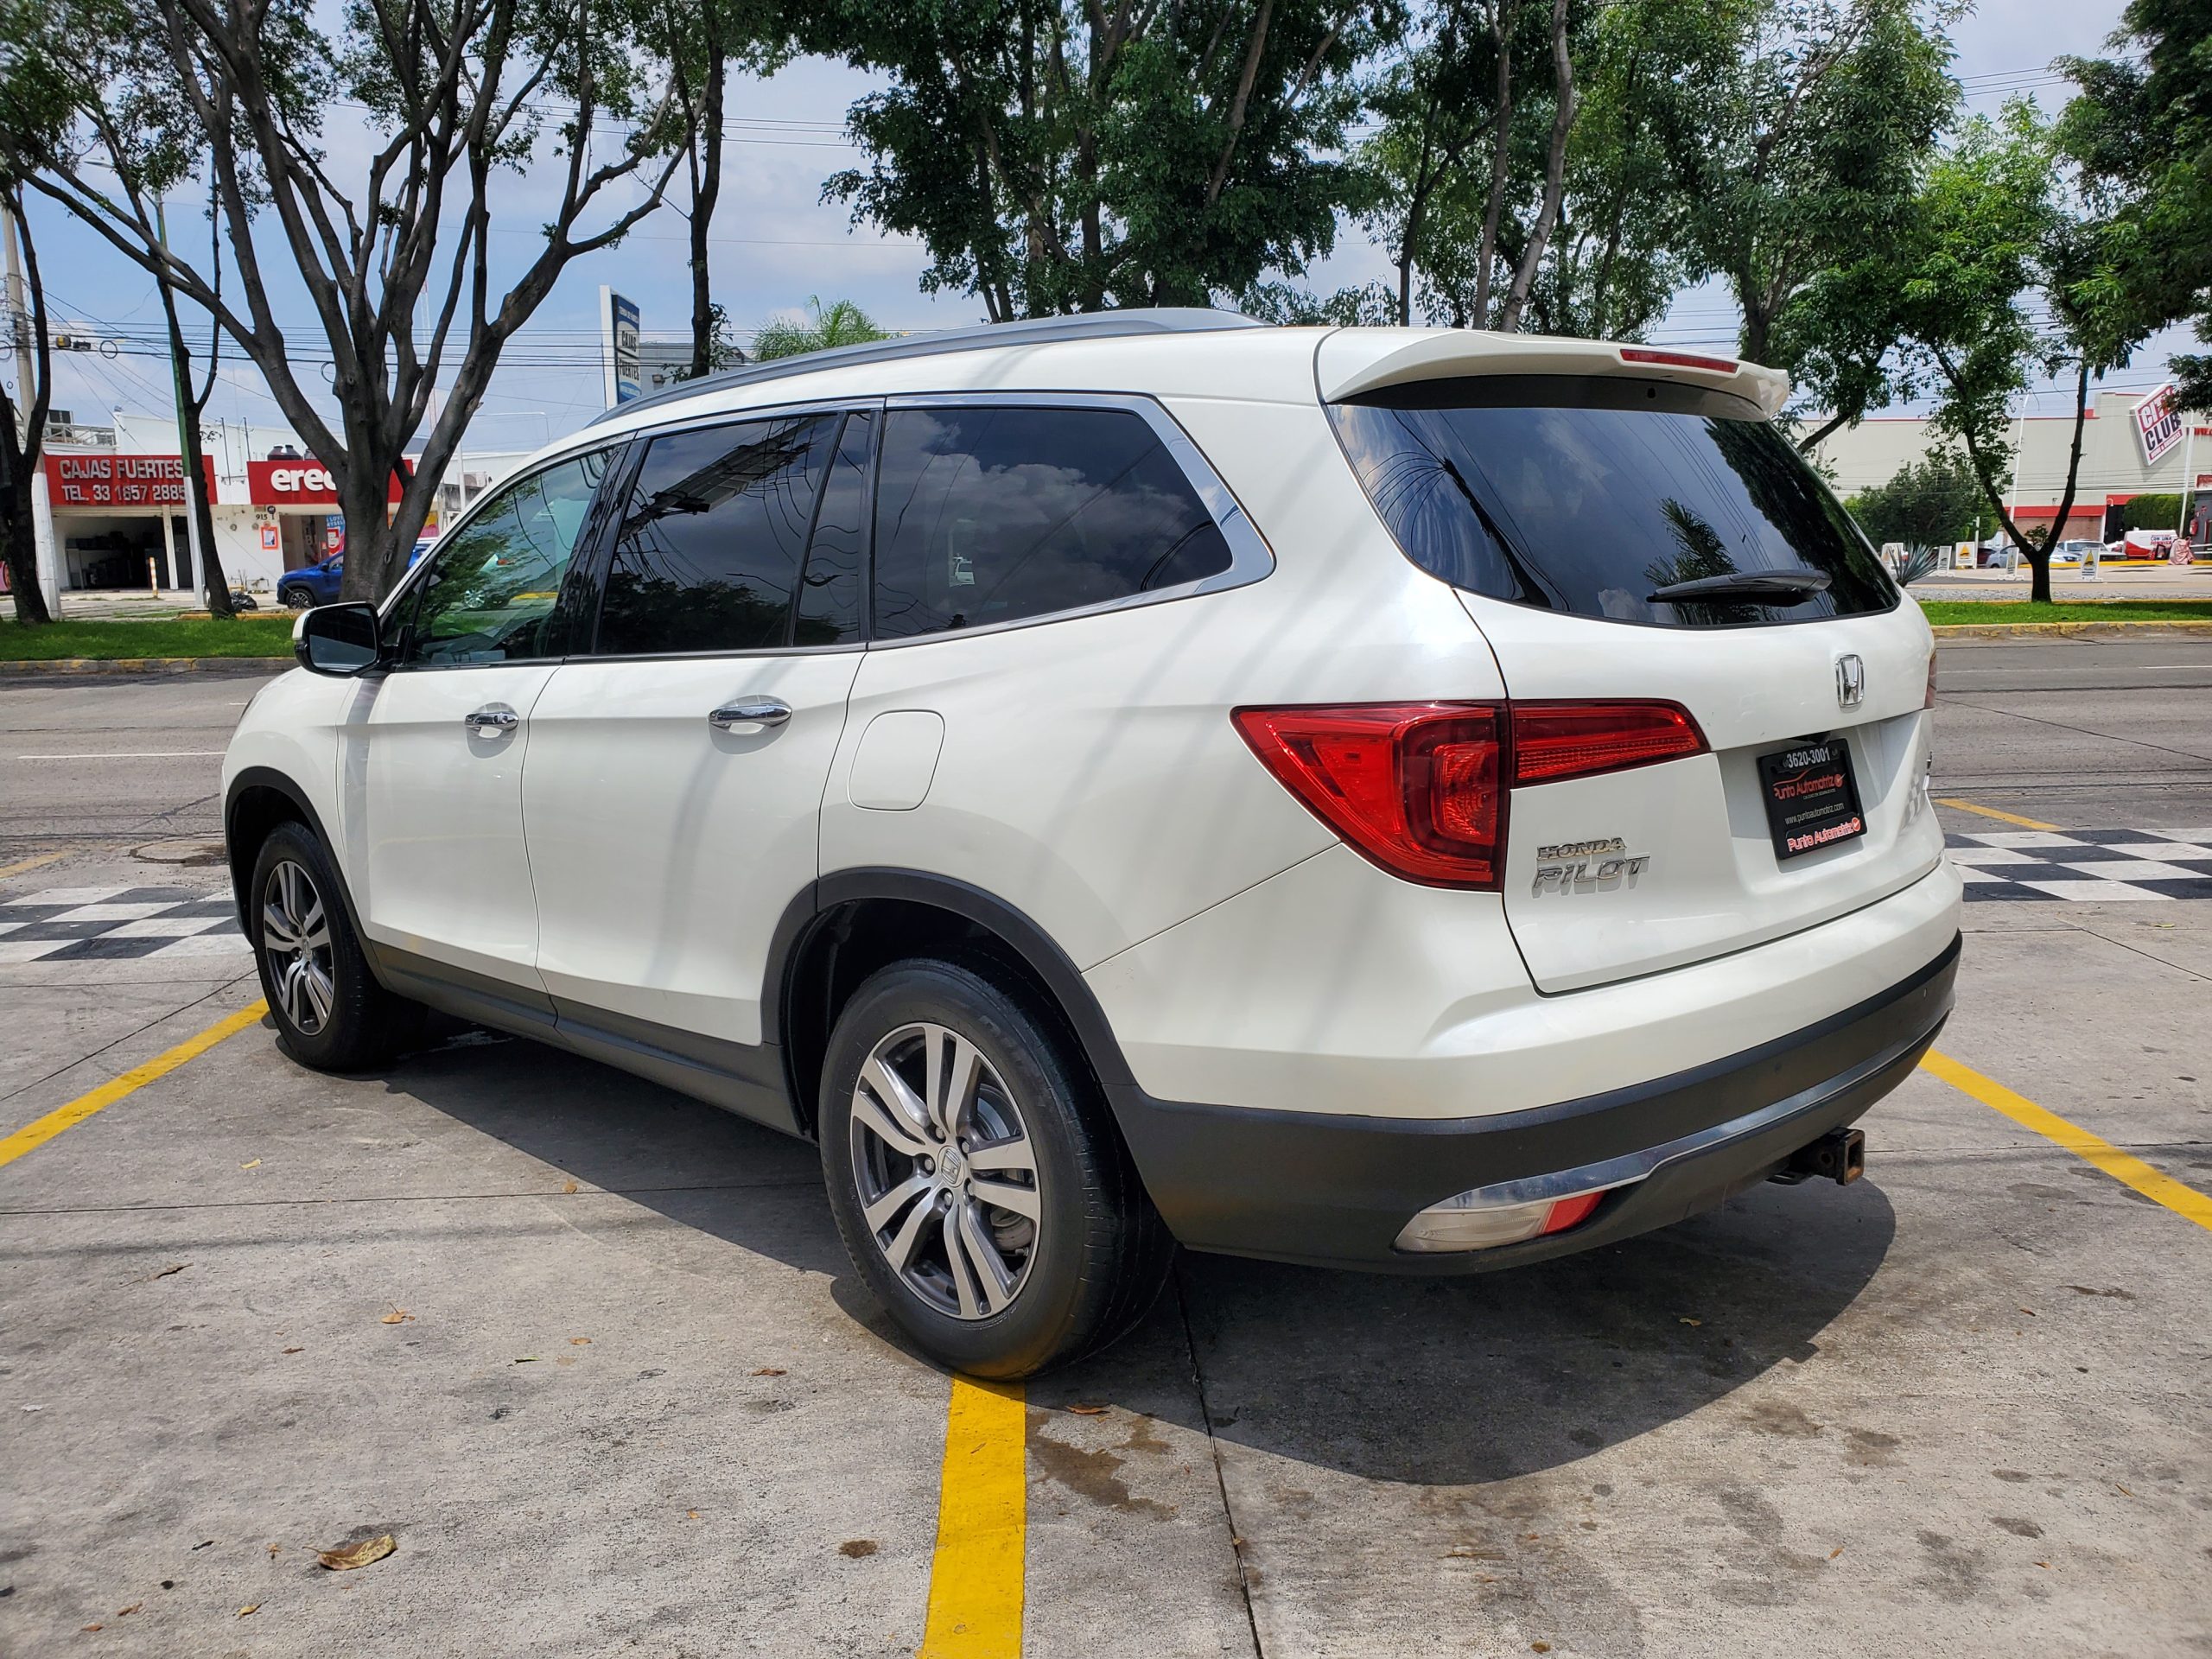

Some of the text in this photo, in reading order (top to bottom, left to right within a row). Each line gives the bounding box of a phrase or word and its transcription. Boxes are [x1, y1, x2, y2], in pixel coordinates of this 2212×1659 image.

[622, 330, 637, 353] CAJAS
[619, 359, 639, 381] FUERTES
[2140, 386, 2179, 429] CIT
[2145, 410, 2182, 451] CLUB
[60, 459, 184, 480] CAJAS FUERTES
[61, 484, 185, 501] TEL. 33 1657 2885
[1787, 747, 1831, 768] 3620-3001
[1774, 774, 1835, 800] Punto Automotriz
[1784, 802, 1845, 825] www.puntoautomotriz.com
[1536, 836, 1626, 861] HONDA
[1787, 821, 1854, 853] Punto Automotriz
[1532, 855, 1650, 890] PILOT
